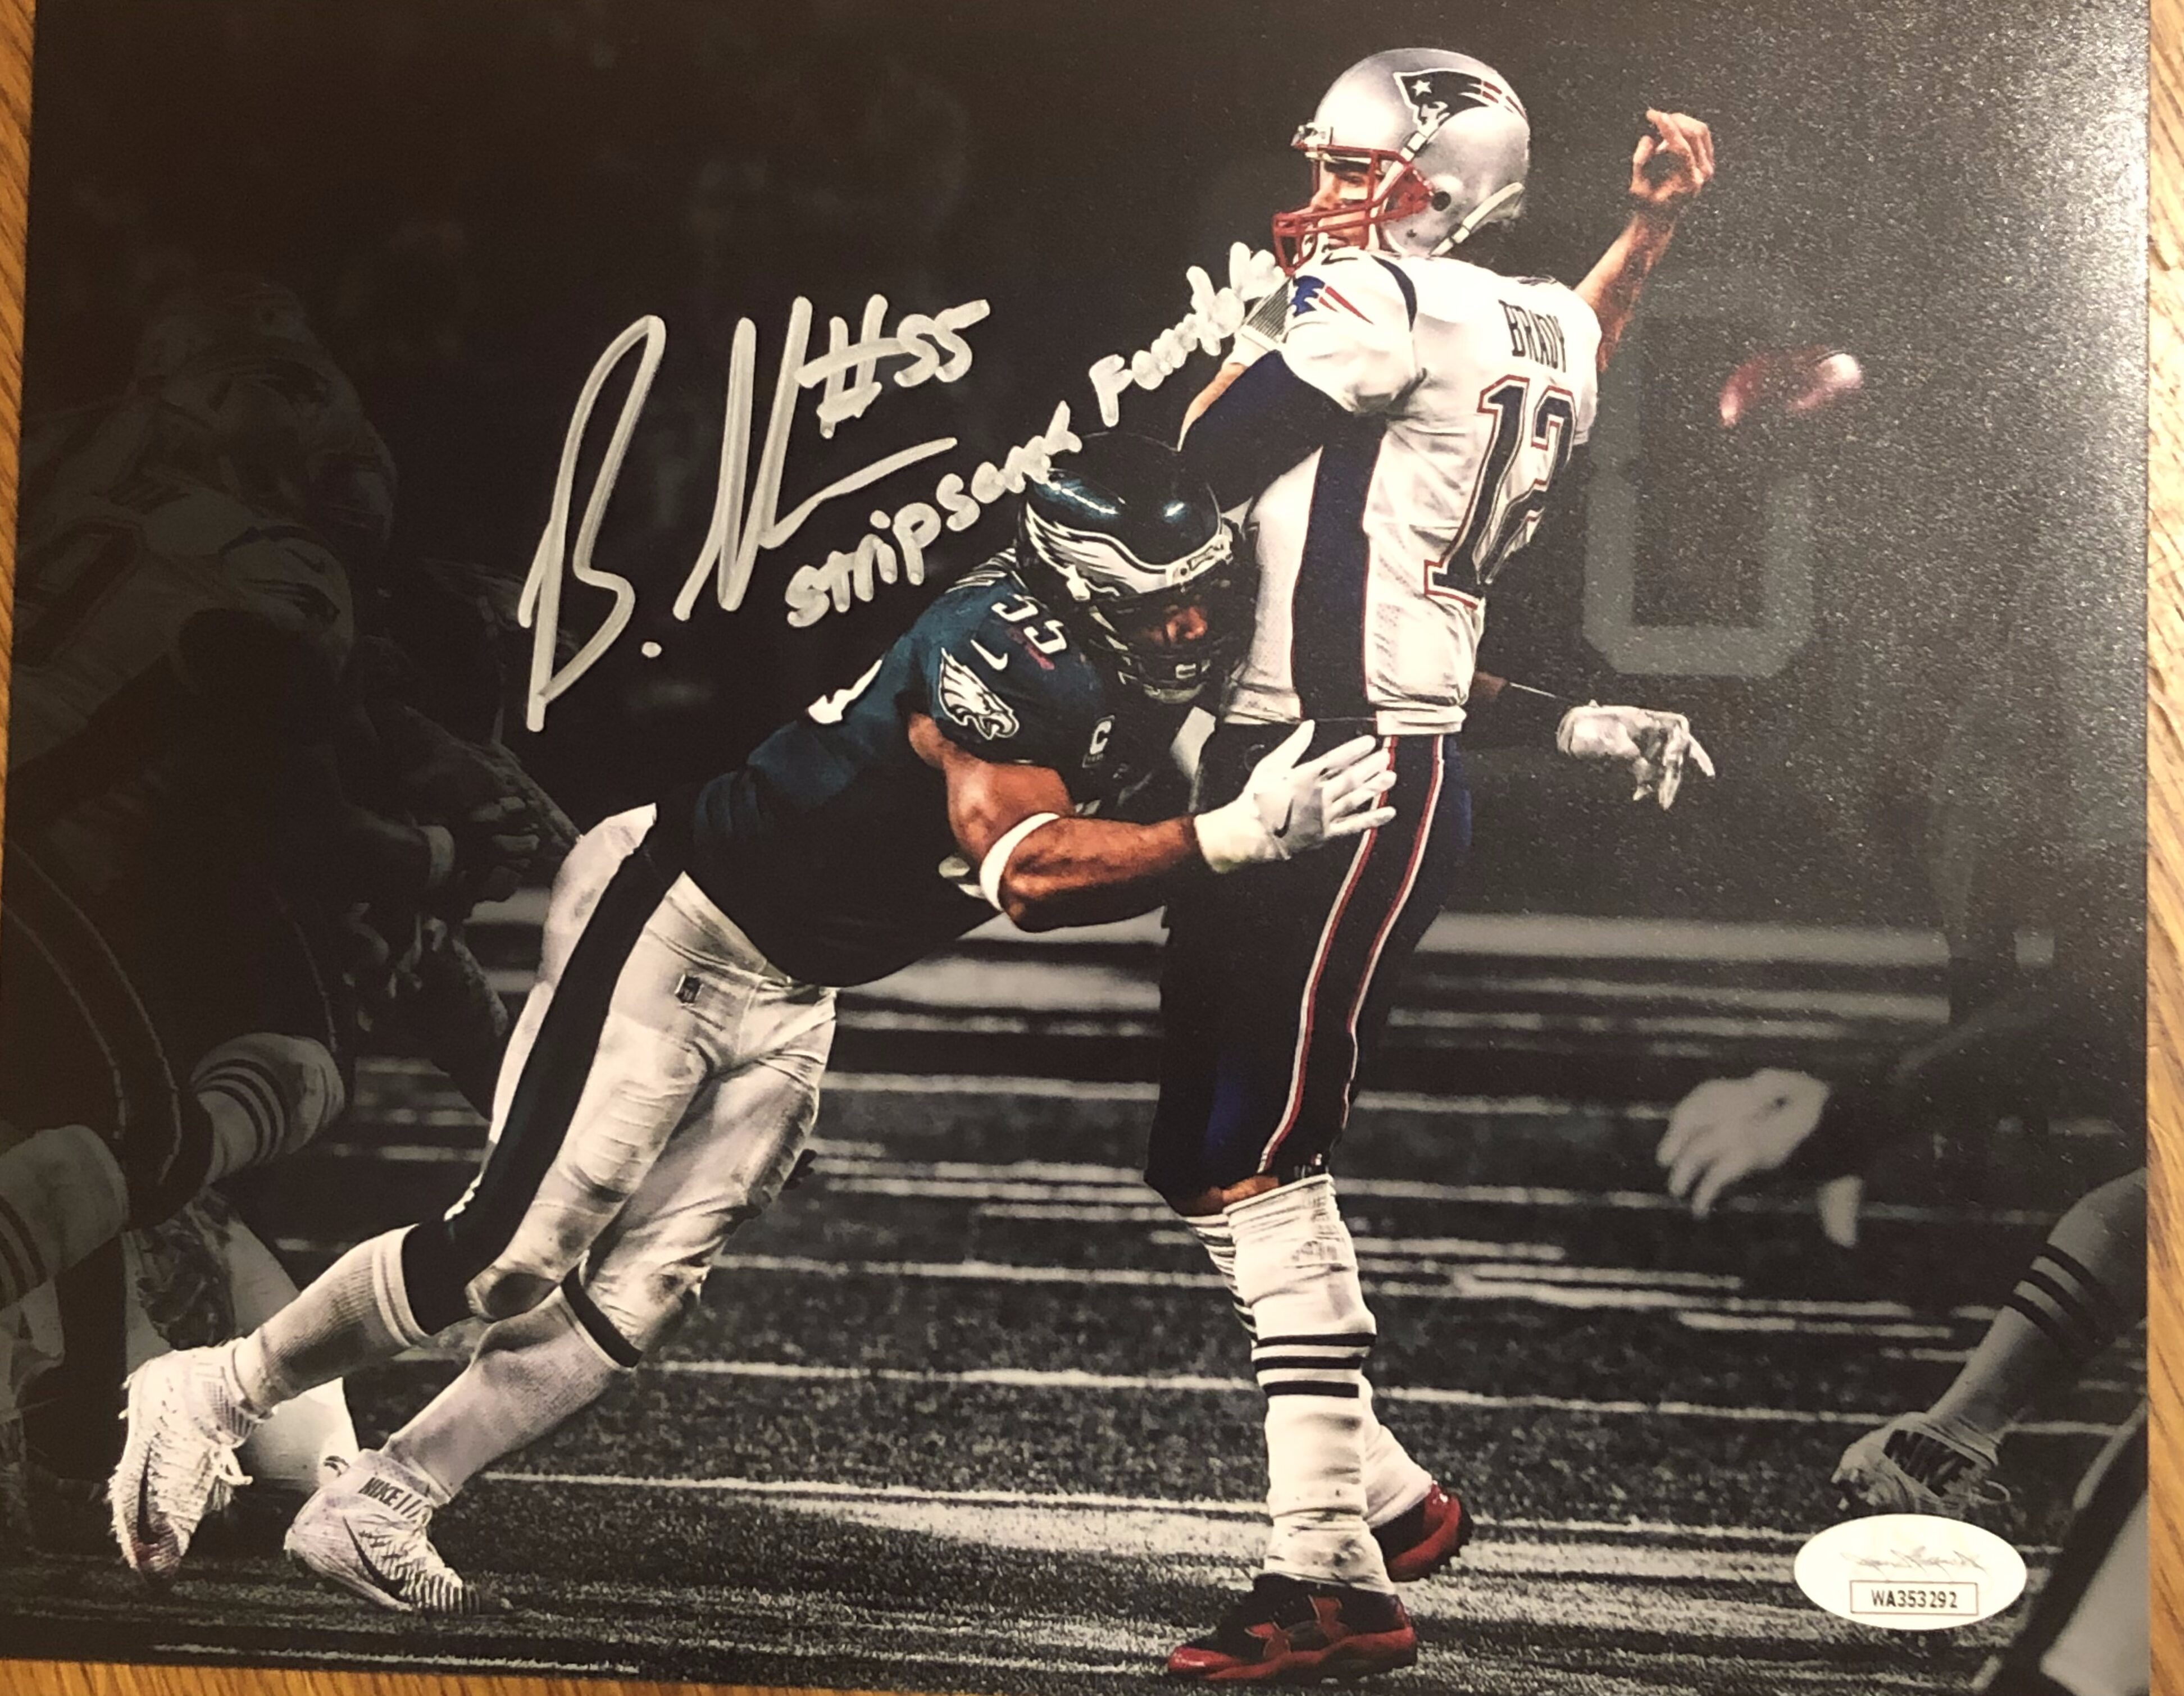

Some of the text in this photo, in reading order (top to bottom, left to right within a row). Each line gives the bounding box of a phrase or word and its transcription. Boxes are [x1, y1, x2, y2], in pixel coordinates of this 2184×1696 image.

[1498, 299, 1567, 373] BRADY
[1424, 374, 1577, 609] 12
[1089, 719, 1112, 755] C
[358, 1476, 404, 1506] NIKE
[1871, 1589, 1958, 1608] WA353292
